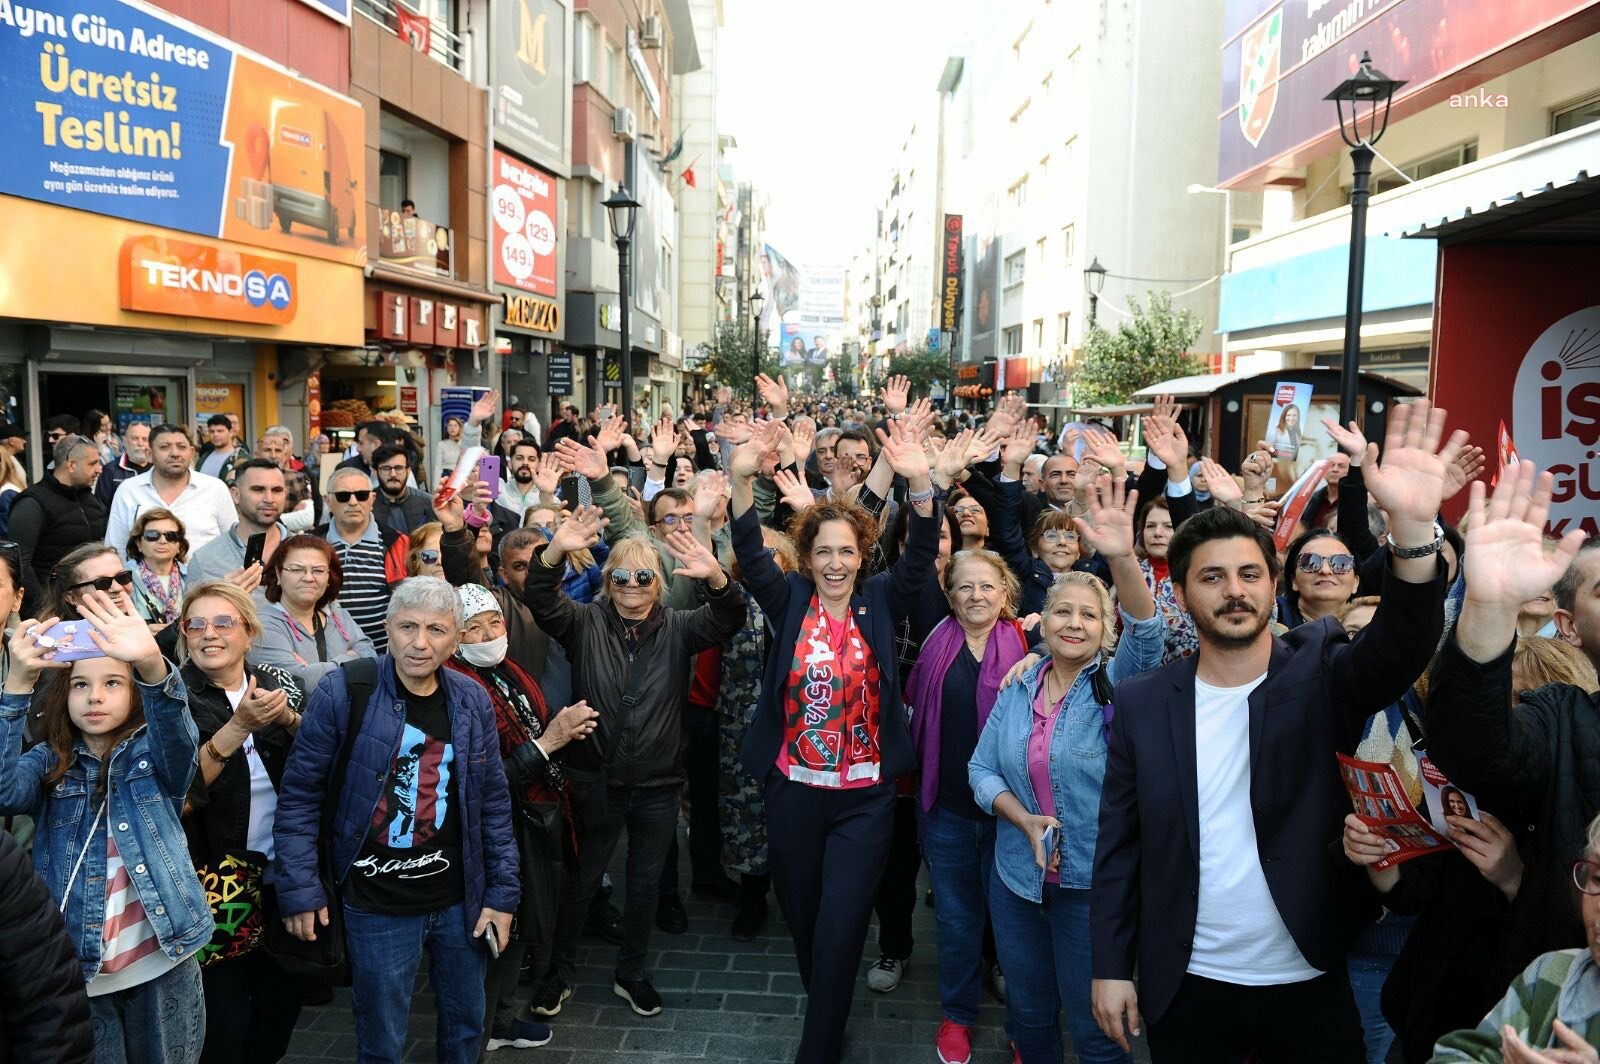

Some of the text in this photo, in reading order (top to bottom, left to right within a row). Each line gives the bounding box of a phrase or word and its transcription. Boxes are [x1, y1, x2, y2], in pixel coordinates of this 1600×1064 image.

[0, 0, 209, 69] Aynı Gün Adrese
[40, 41, 178, 113] Ücretsiz
[35, 101, 182, 160] Teslim!
[43, 180, 65, 192] aynı
[65, 180, 83, 193] gün
[83, 181, 119, 195] ücretsiz
[119, 184, 145, 196] teslim
[50, 160, 116, 178] Mağazamızdan
[116, 167, 151, 181] aldığınız
[498, 198, 516, 218] 99
[529, 222, 549, 242] 129
[504, 245, 527, 266] 149
[946, 235, 959, 274] Tavuk
[141, 260, 290, 302] TEKNOSA
[503, 293, 560, 333] MEZZO
